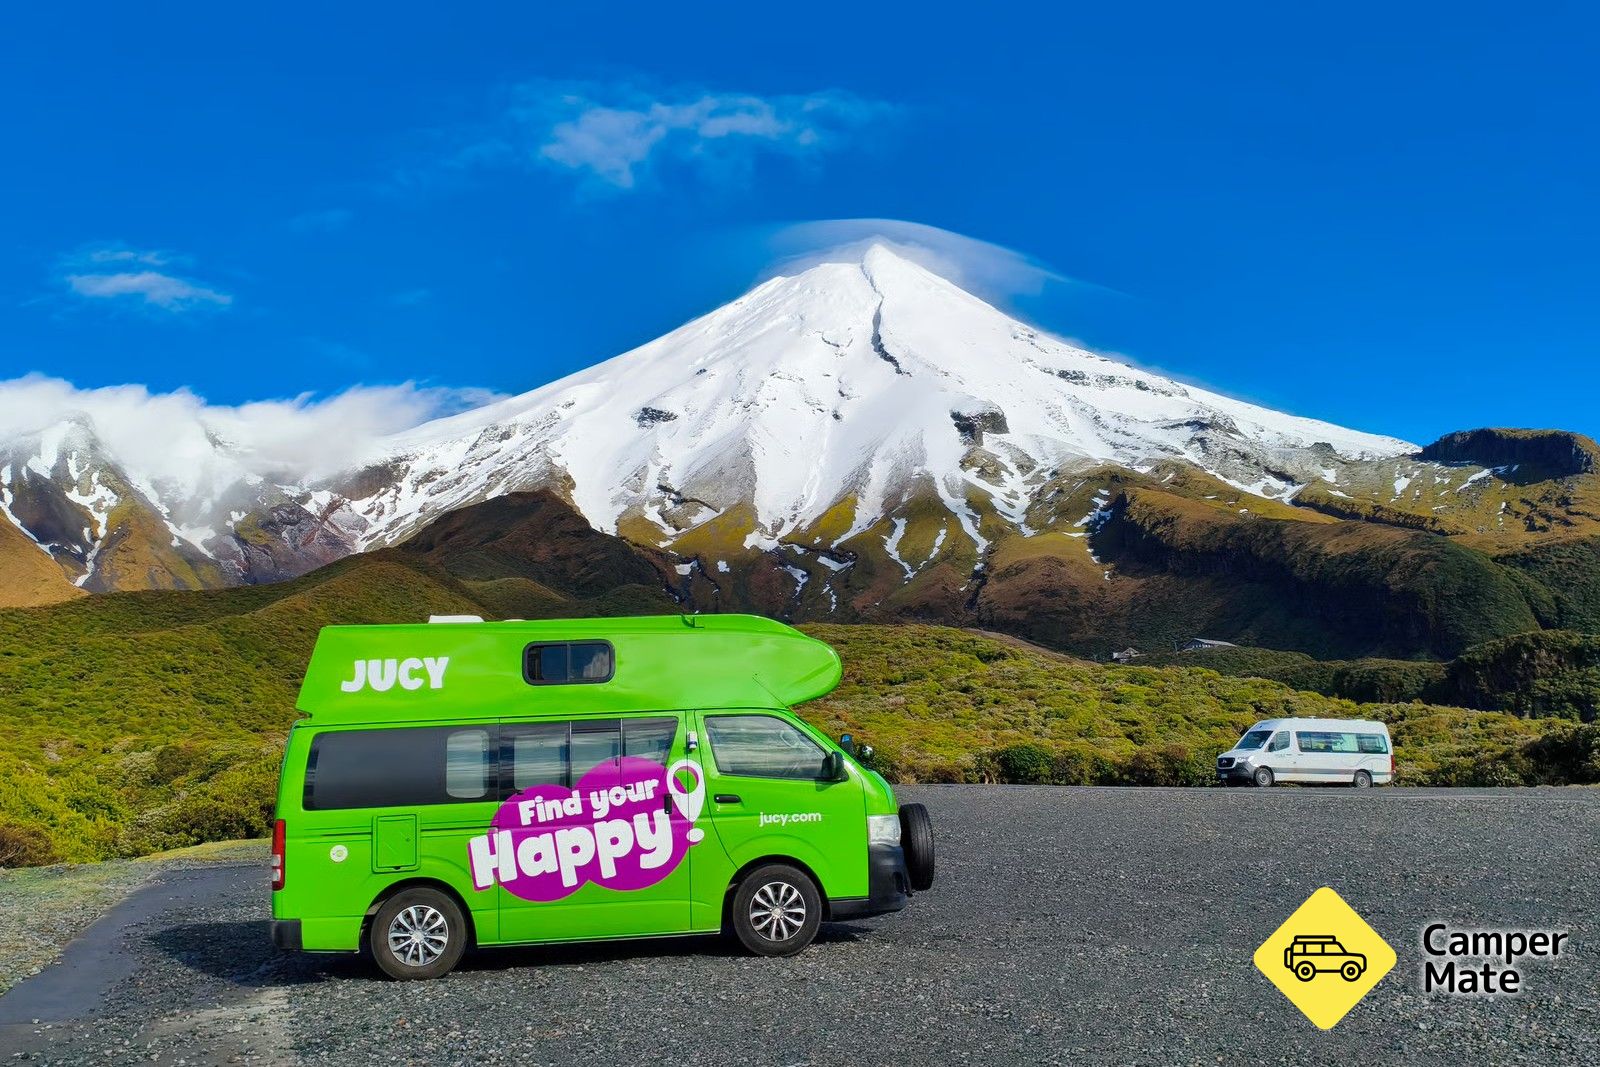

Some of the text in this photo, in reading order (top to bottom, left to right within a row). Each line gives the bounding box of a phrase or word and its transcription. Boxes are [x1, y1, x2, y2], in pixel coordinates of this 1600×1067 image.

[340, 656, 450, 693] JUCY
[518, 778, 659, 826] Find your
[759, 811, 822, 828] jucy.com
